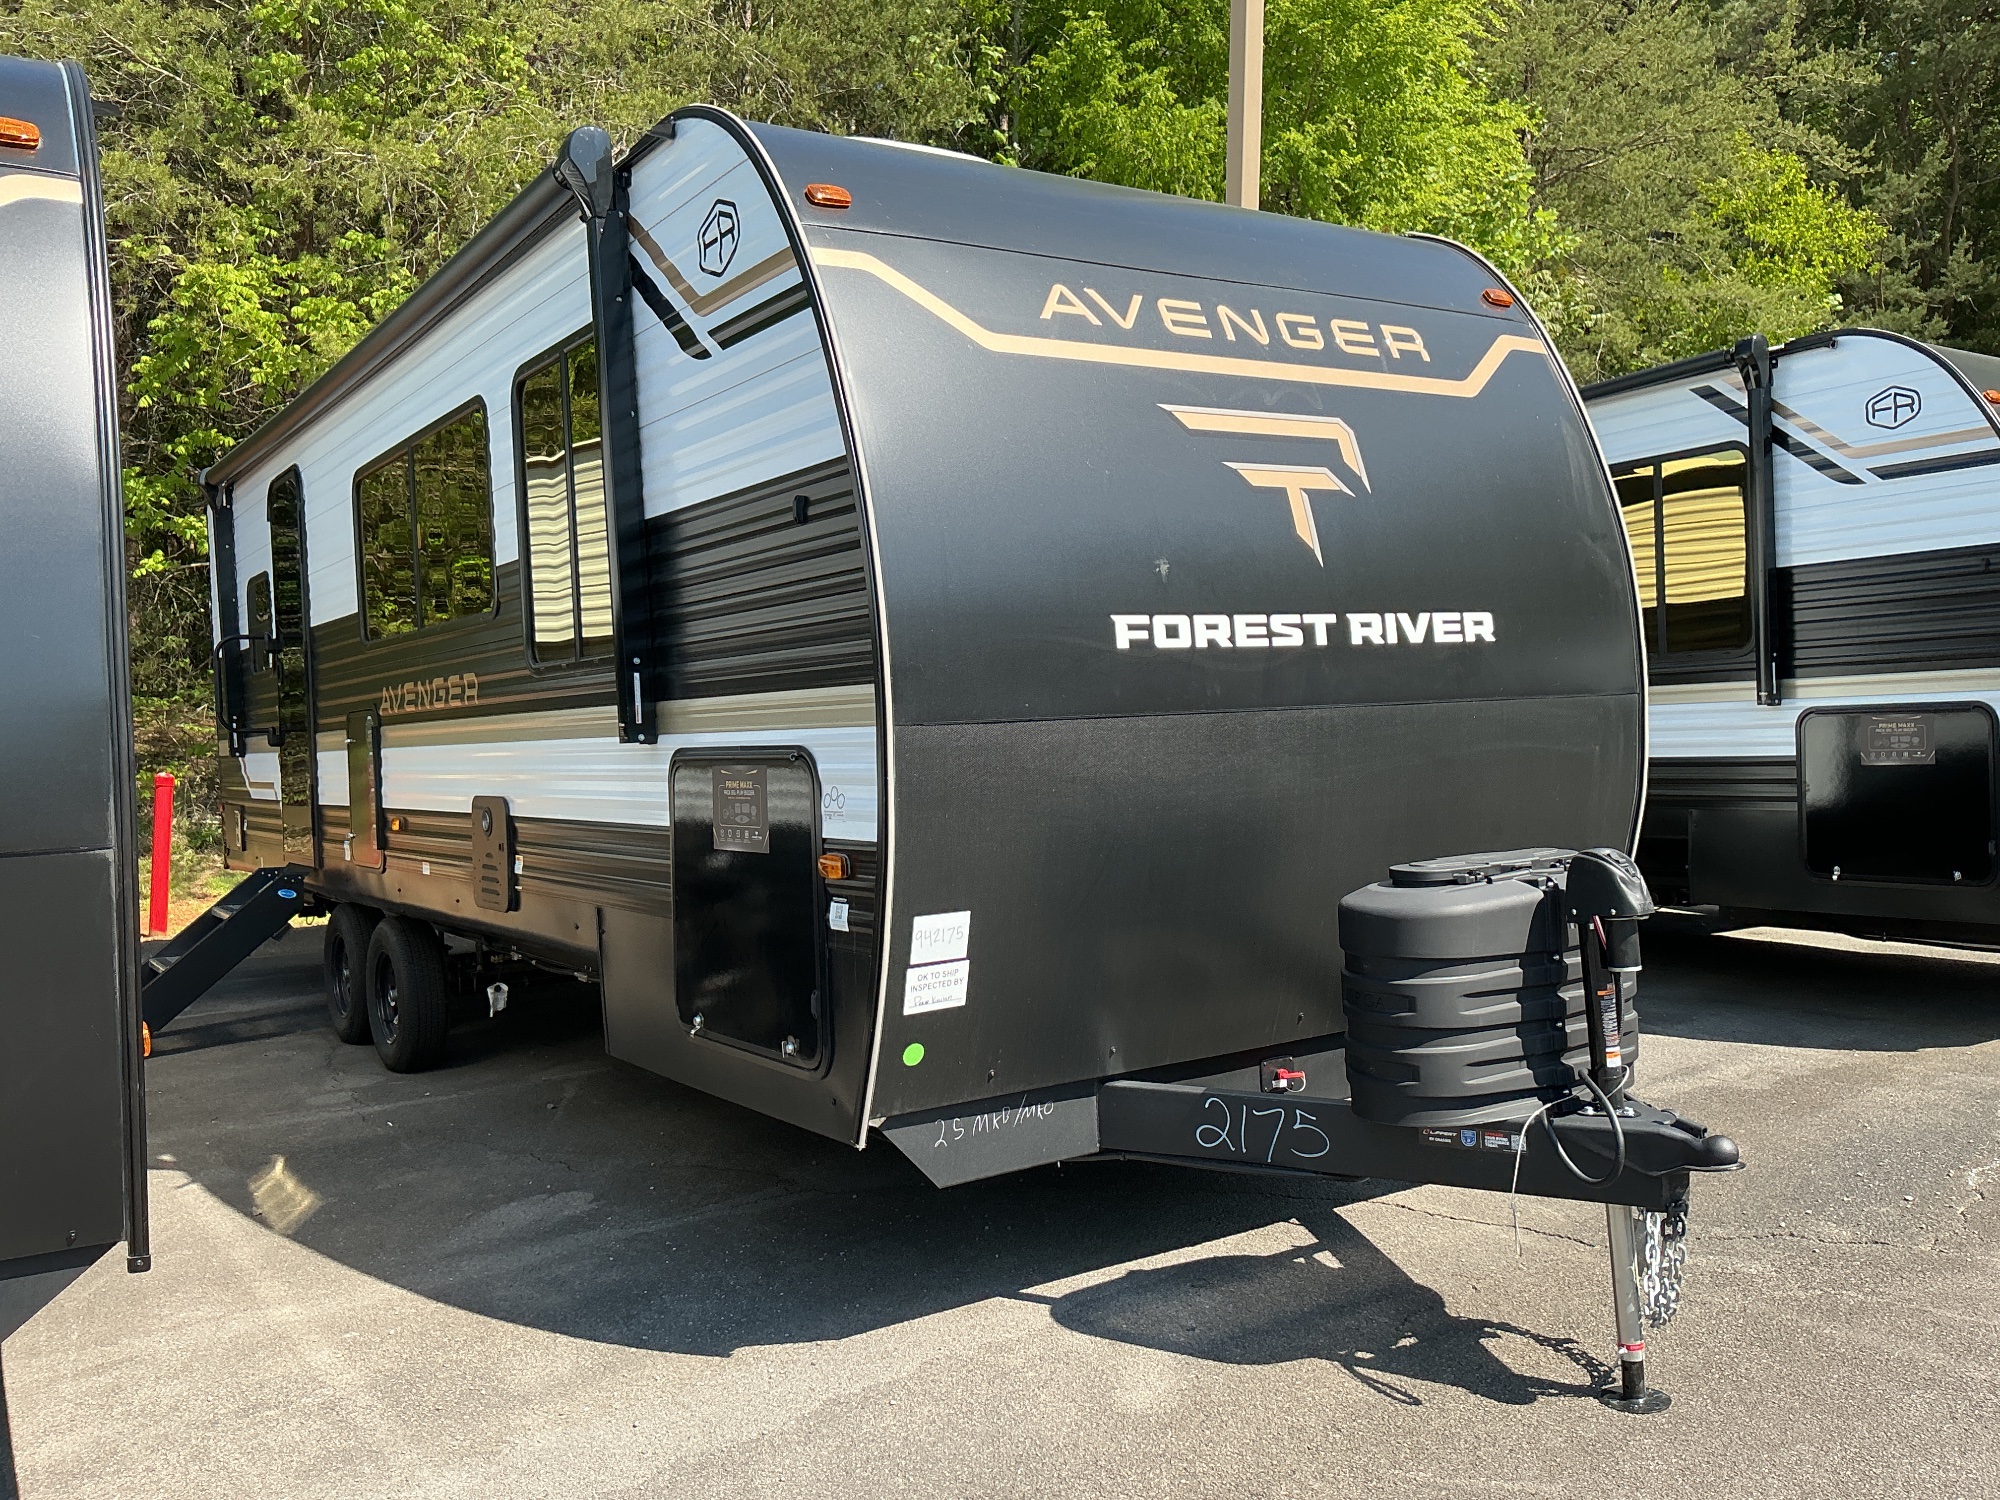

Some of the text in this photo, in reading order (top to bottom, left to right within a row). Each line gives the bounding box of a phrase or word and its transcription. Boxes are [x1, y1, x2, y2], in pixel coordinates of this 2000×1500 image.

[1040, 283, 1430, 362] AVENGER
[1110, 611, 1497, 650] FOREST RIVER
[379, 672, 479, 716] AVENGER
[915, 926, 964, 949] 942175
[910, 976, 965, 993] INSPECTED BY
[917, 968, 959, 982] OK TO SHIP
[1195, 1097, 1330, 1163] 2175
